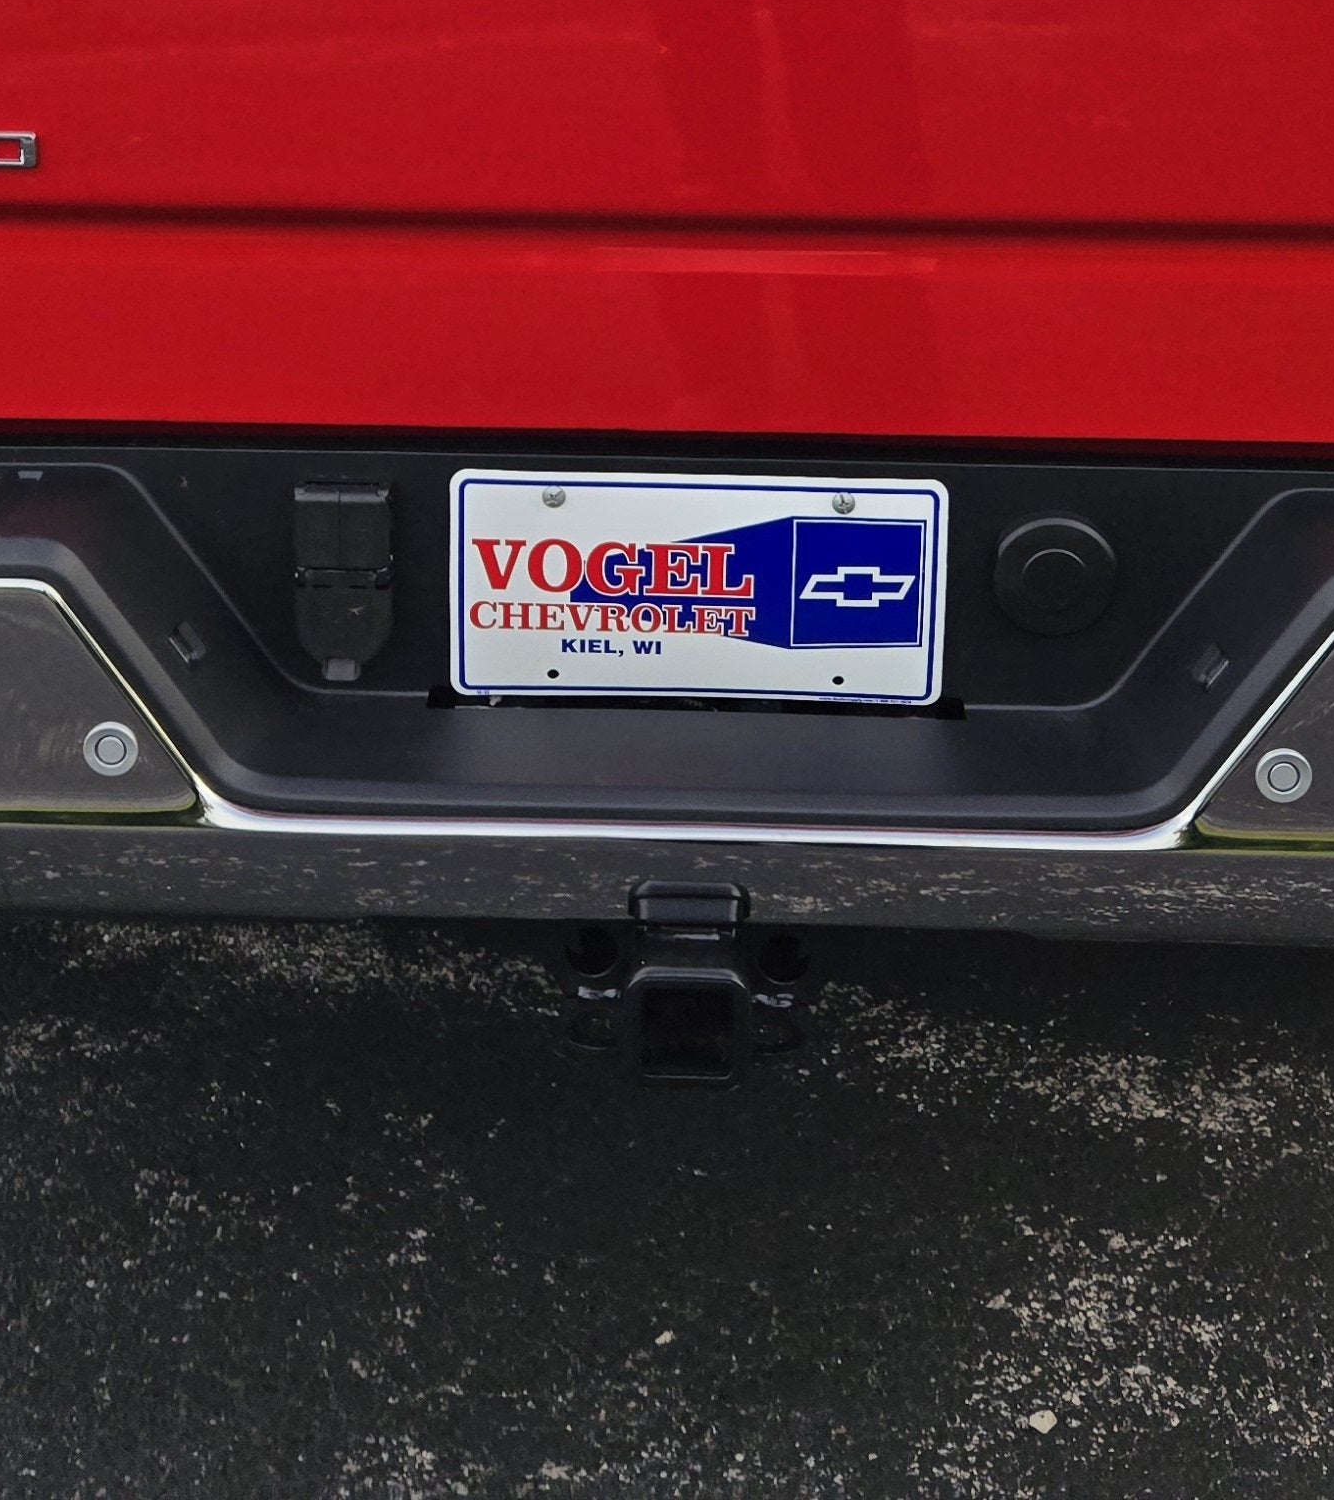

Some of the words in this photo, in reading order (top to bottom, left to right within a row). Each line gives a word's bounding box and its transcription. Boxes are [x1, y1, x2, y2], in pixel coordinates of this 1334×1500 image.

[471, 537, 755, 599] VOGEL
[469, 600, 756, 637] CHEVROLET
[561, 638, 624, 657] KIEL,
[632, 640, 662, 654] WI
